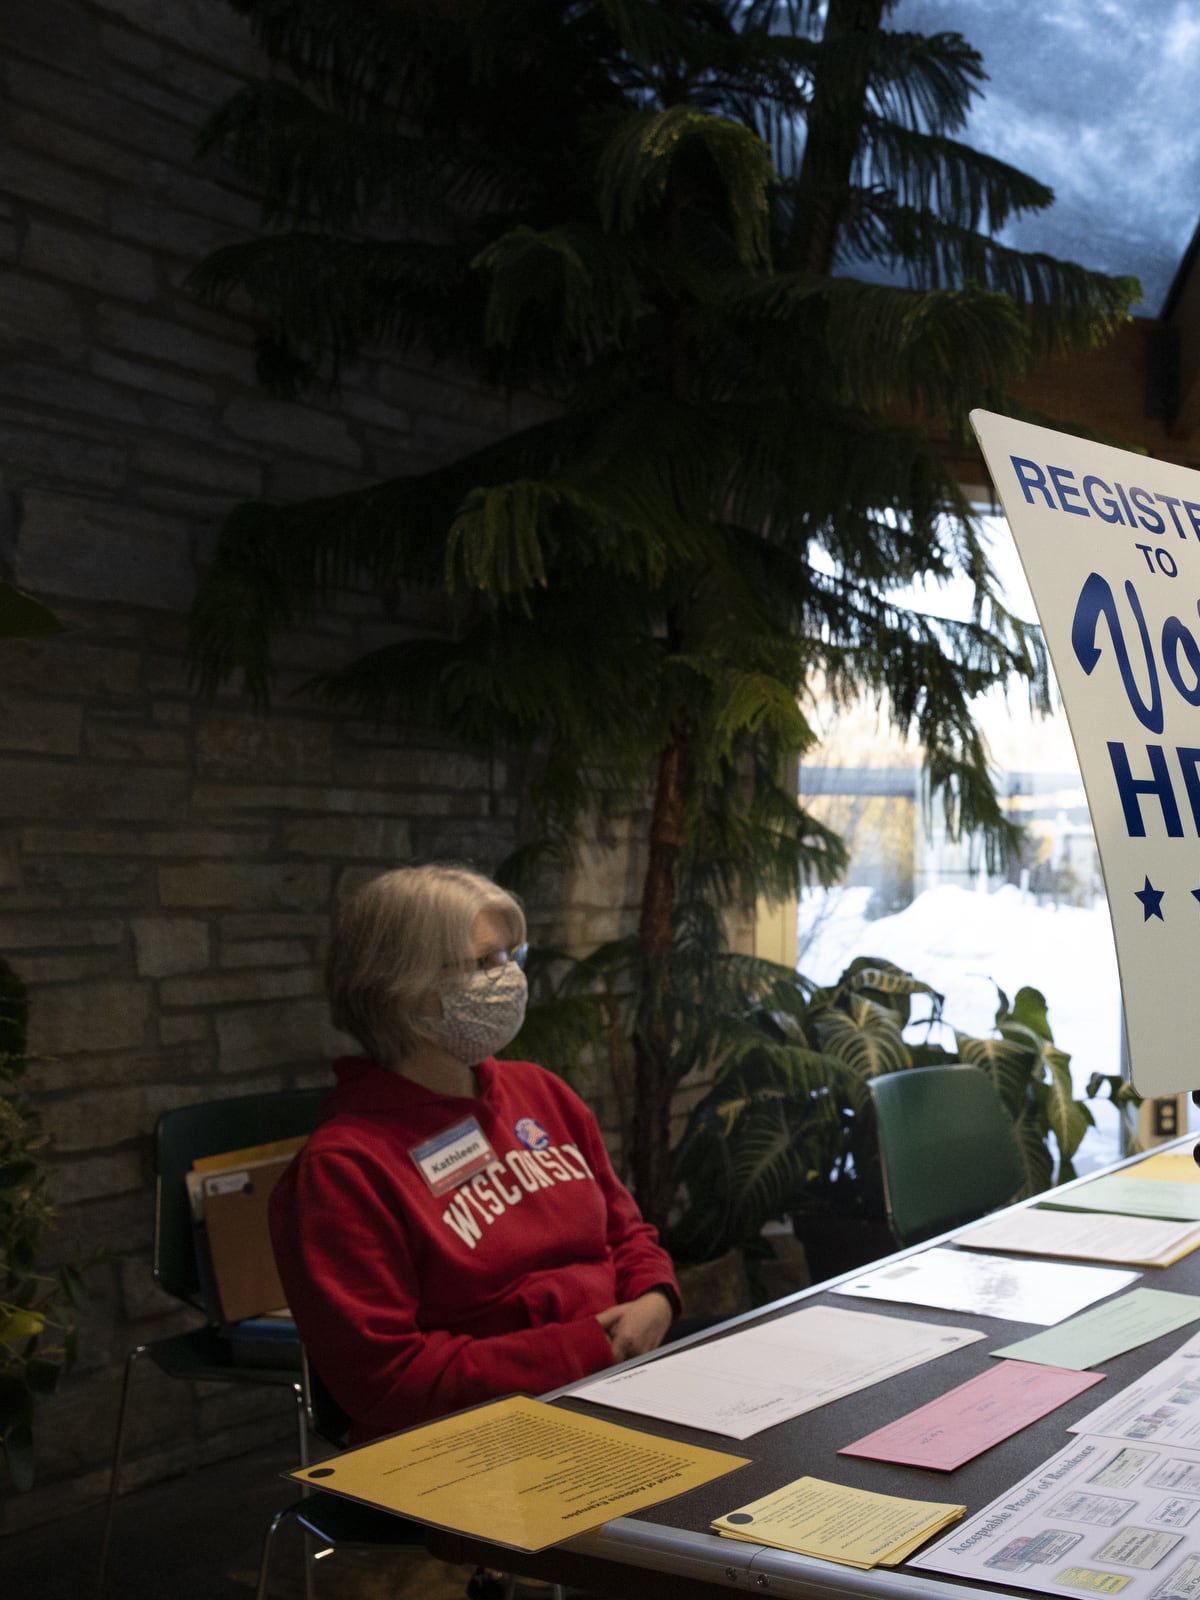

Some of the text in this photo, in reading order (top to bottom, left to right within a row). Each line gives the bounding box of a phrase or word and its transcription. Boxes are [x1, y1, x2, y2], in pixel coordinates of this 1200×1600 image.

[1135, 543, 1178, 578] TO
[430, 1141, 481, 1174] Kathleen
[948, 1511, 1012, 1555] Acceptable
[1004, 1488, 1041, 1512] Proof
[1038, 1478, 1052, 1491] of
[1046, 1445, 1096, 1481] Residence
